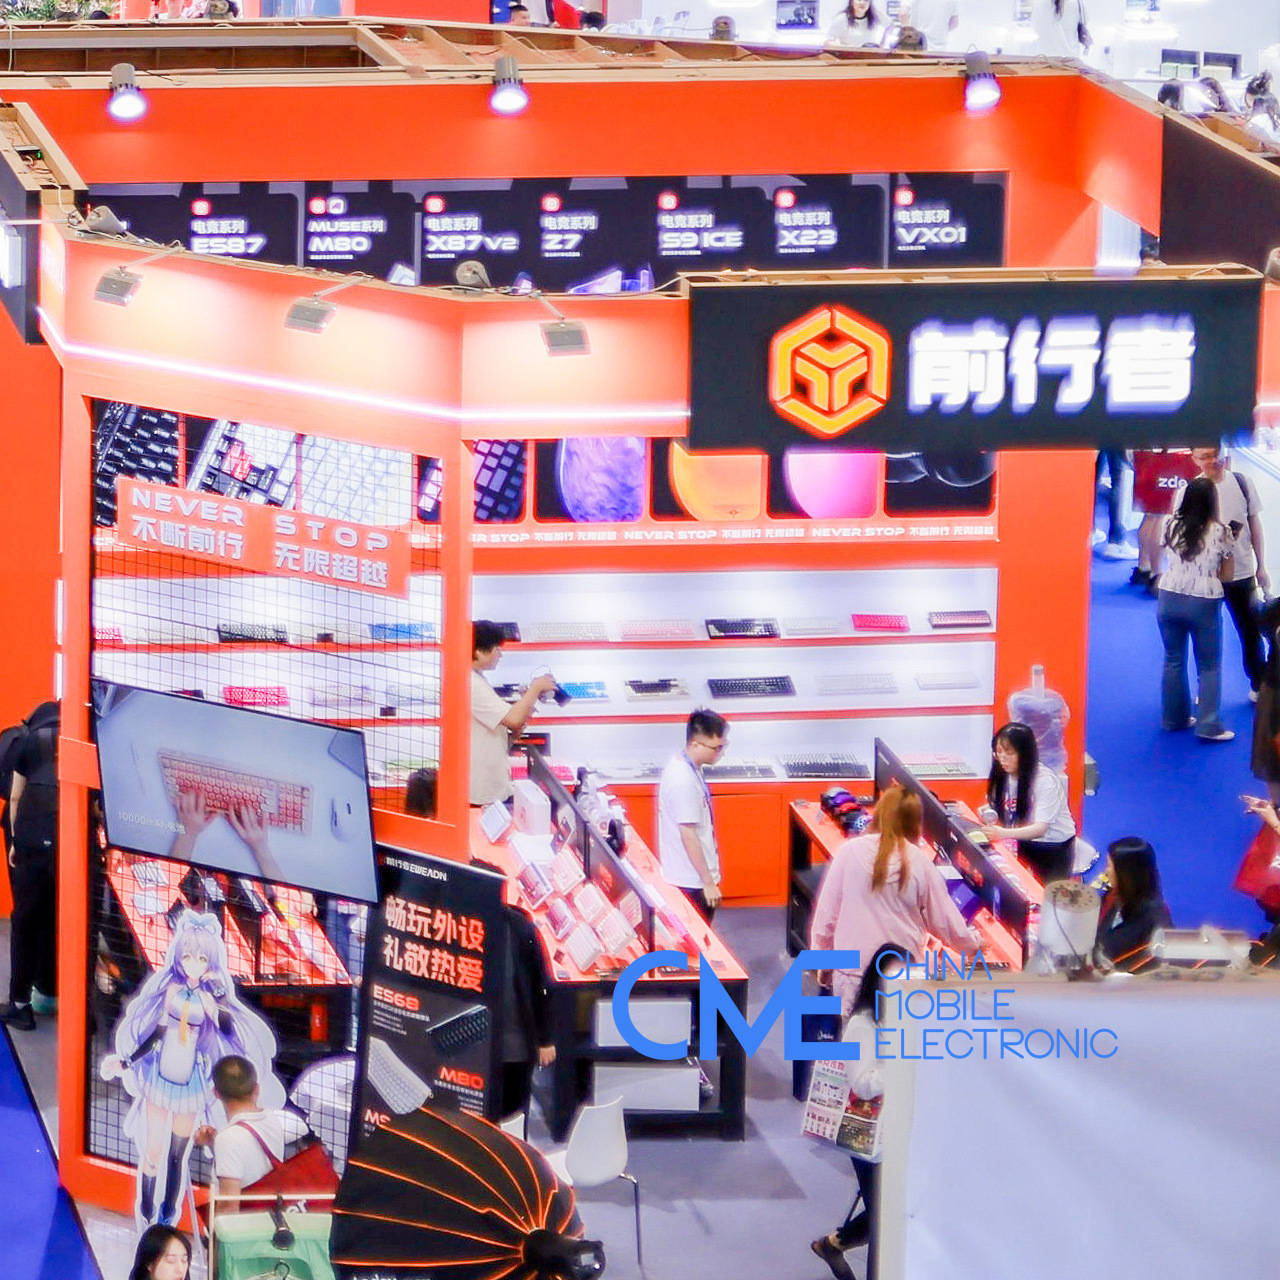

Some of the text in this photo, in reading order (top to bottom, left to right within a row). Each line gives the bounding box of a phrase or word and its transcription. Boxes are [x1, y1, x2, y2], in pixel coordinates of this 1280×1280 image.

[543, 234, 583, 250] Z7
[661, 231, 743, 248] S9 ICE
[778, 229, 837, 246] X23
[897, 227, 967, 243] VX01
[192, 237, 265, 254] ES87
[310, 237, 370, 252] M80
[908, 314, 1194, 410] 前行者
[1158, 476, 1189, 488] zde
[131, 487, 389, 551] NEVER STOP
[624, 530, 674, 540] NEVER
[678, 529, 717, 539] STOP
[812, 527, 861, 537] NEVER
[864, 527, 906, 536] STOP
[131, 515, 388, 589] 不断前行 无限超越
[385, 895, 485, 952] 畅玩外设
[384, 935, 483, 993] 礼敬热爱
[373, 985, 420, 1011] ES68
[439, 1067, 484, 1089] M80
